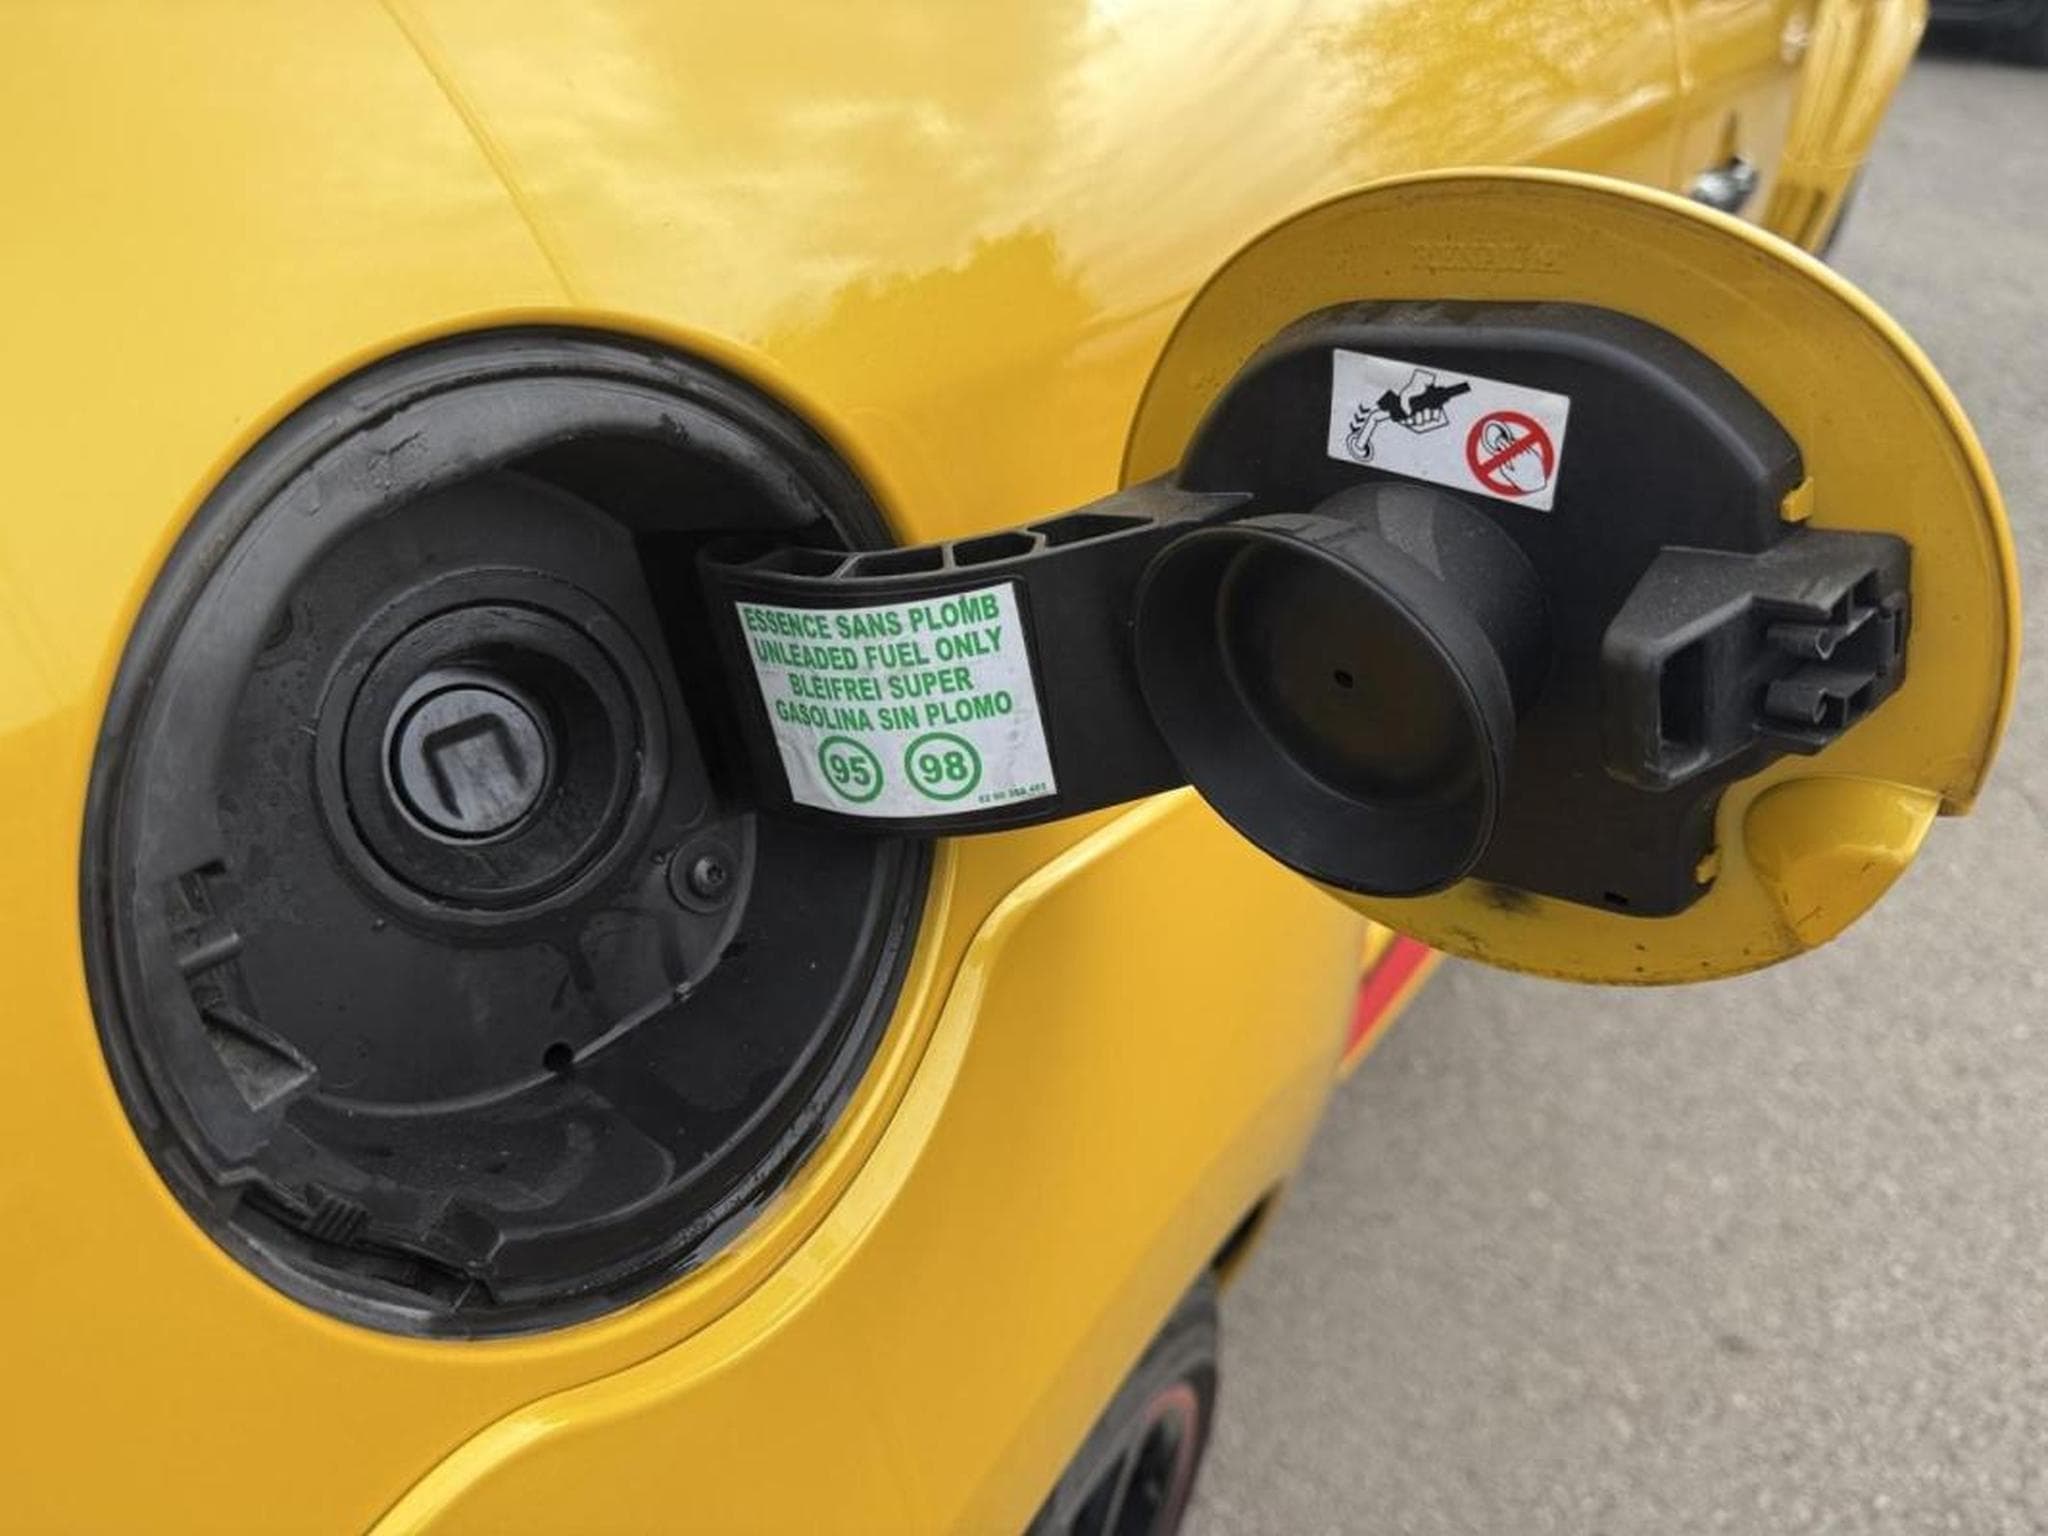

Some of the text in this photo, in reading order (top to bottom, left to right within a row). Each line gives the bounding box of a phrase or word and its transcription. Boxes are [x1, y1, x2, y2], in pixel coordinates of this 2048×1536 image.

[744, 594, 1000, 640] ESSENCE SANS PLOMB
[753, 625, 1002, 671] UNLEADED FUEL ONLY
[787, 667, 974, 702] BLEIFREI SUPER
[775, 690, 1013, 732] GASOLINA SIN PLOMO
[829, 751, 969, 786] 95 98
